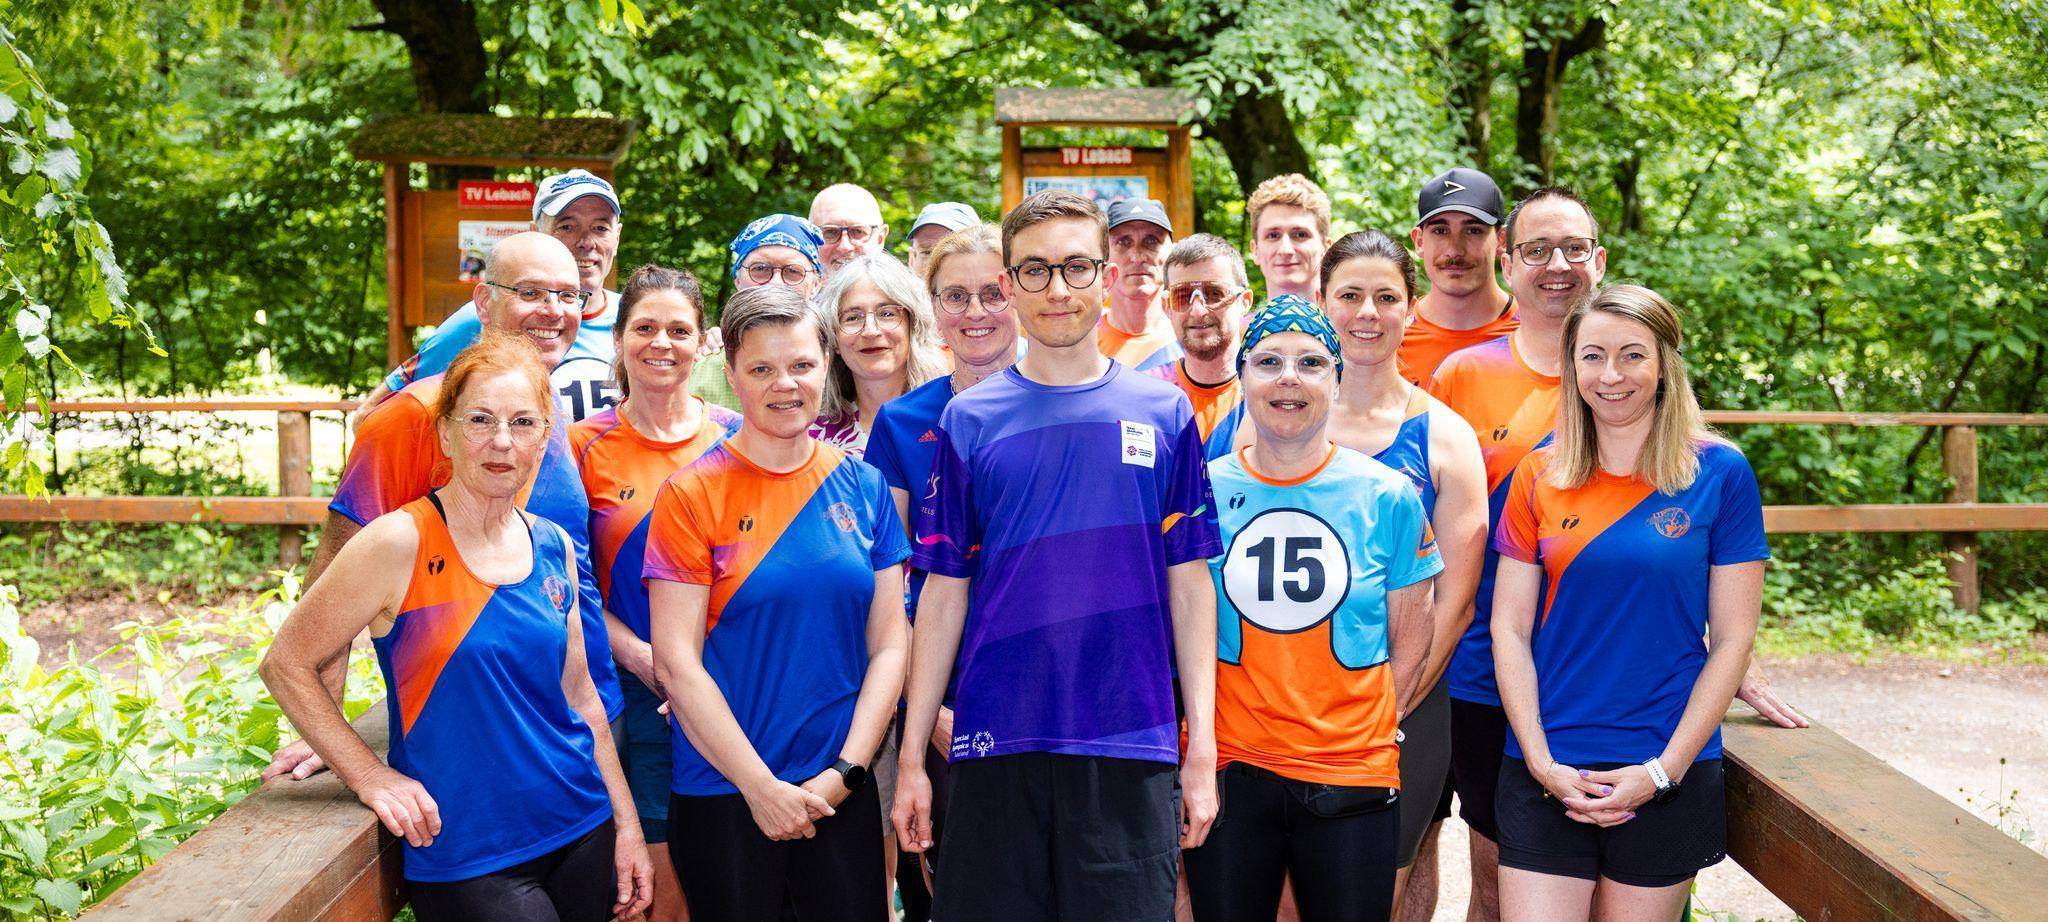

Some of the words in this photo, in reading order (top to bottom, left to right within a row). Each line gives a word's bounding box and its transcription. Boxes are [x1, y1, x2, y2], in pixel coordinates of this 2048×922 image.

[1062, 147, 1079, 164] TV
[1083, 147, 1132, 165] Lebach
[464, 187, 483, 201] TV
[485, 187, 531, 201] Lebach
[559, 380, 619, 423] 15
[1246, 537, 1326, 603] 15
